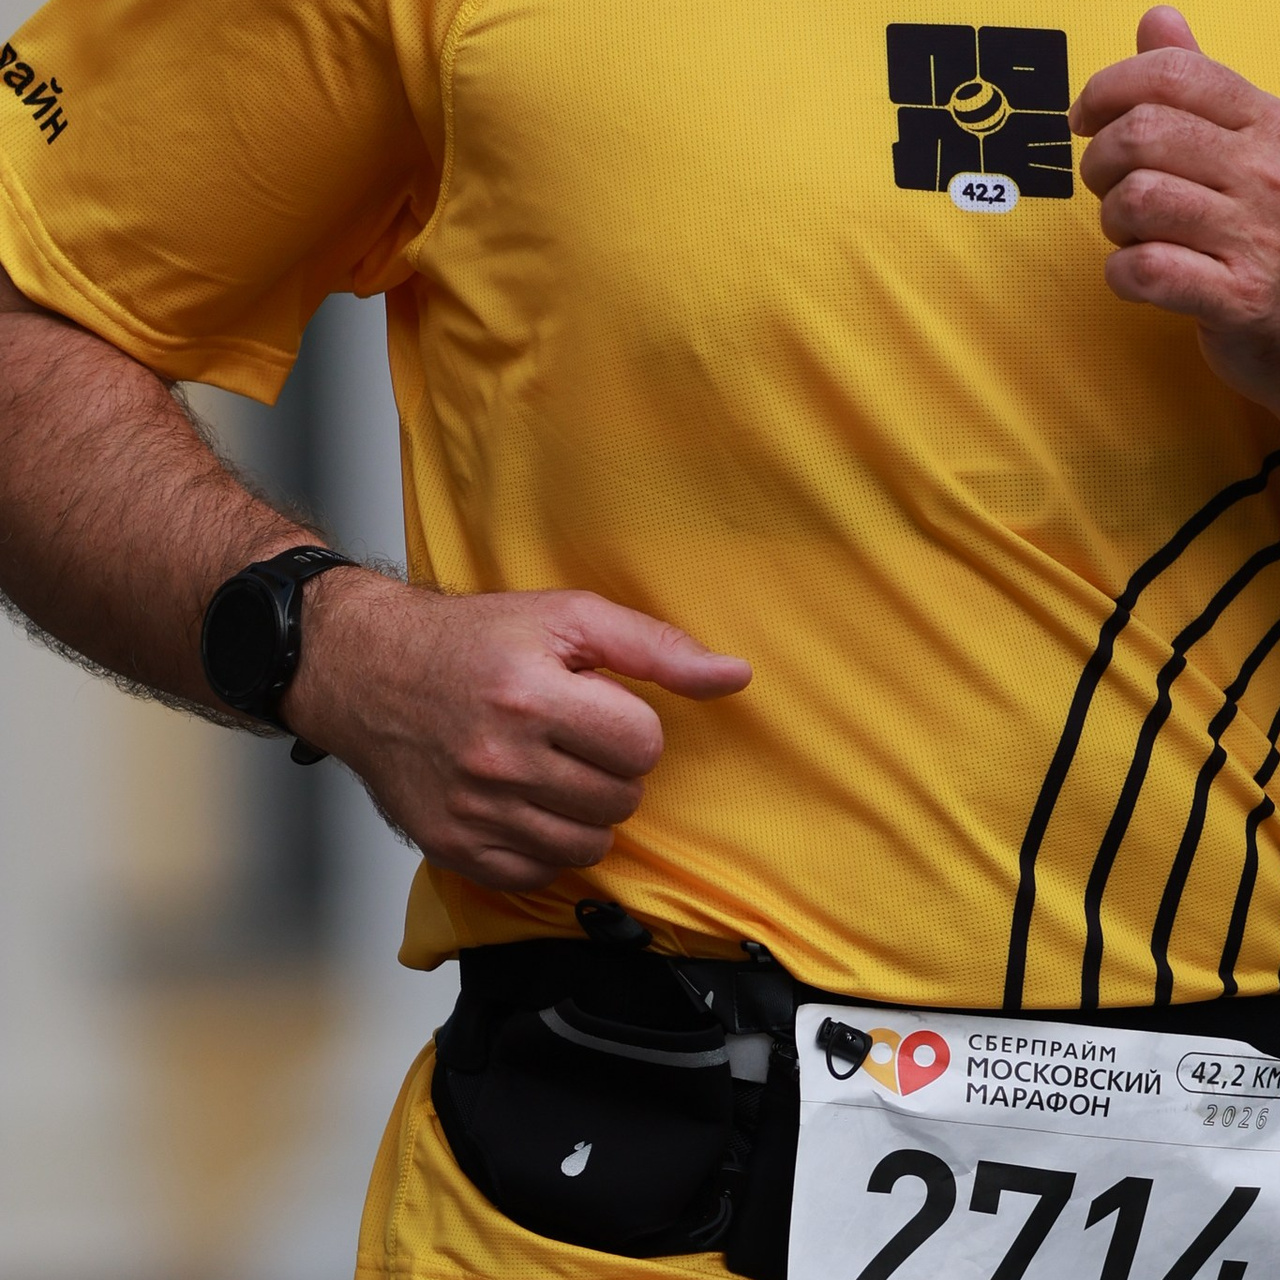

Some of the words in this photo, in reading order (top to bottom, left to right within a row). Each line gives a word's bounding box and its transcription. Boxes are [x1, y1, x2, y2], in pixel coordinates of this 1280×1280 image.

[962, 183, 1006, 204] 42,2
[968, 1034, 1116, 1063] СБЕРПРАЙМ
[966, 1057, 1161, 1095] МОСКОВСКИЙ
[1191, 1061, 1245, 1089] 42,2
[966, 1083, 1111, 1117] МАРАФОН
[1203, 1104, 1269, 1130] 2026
